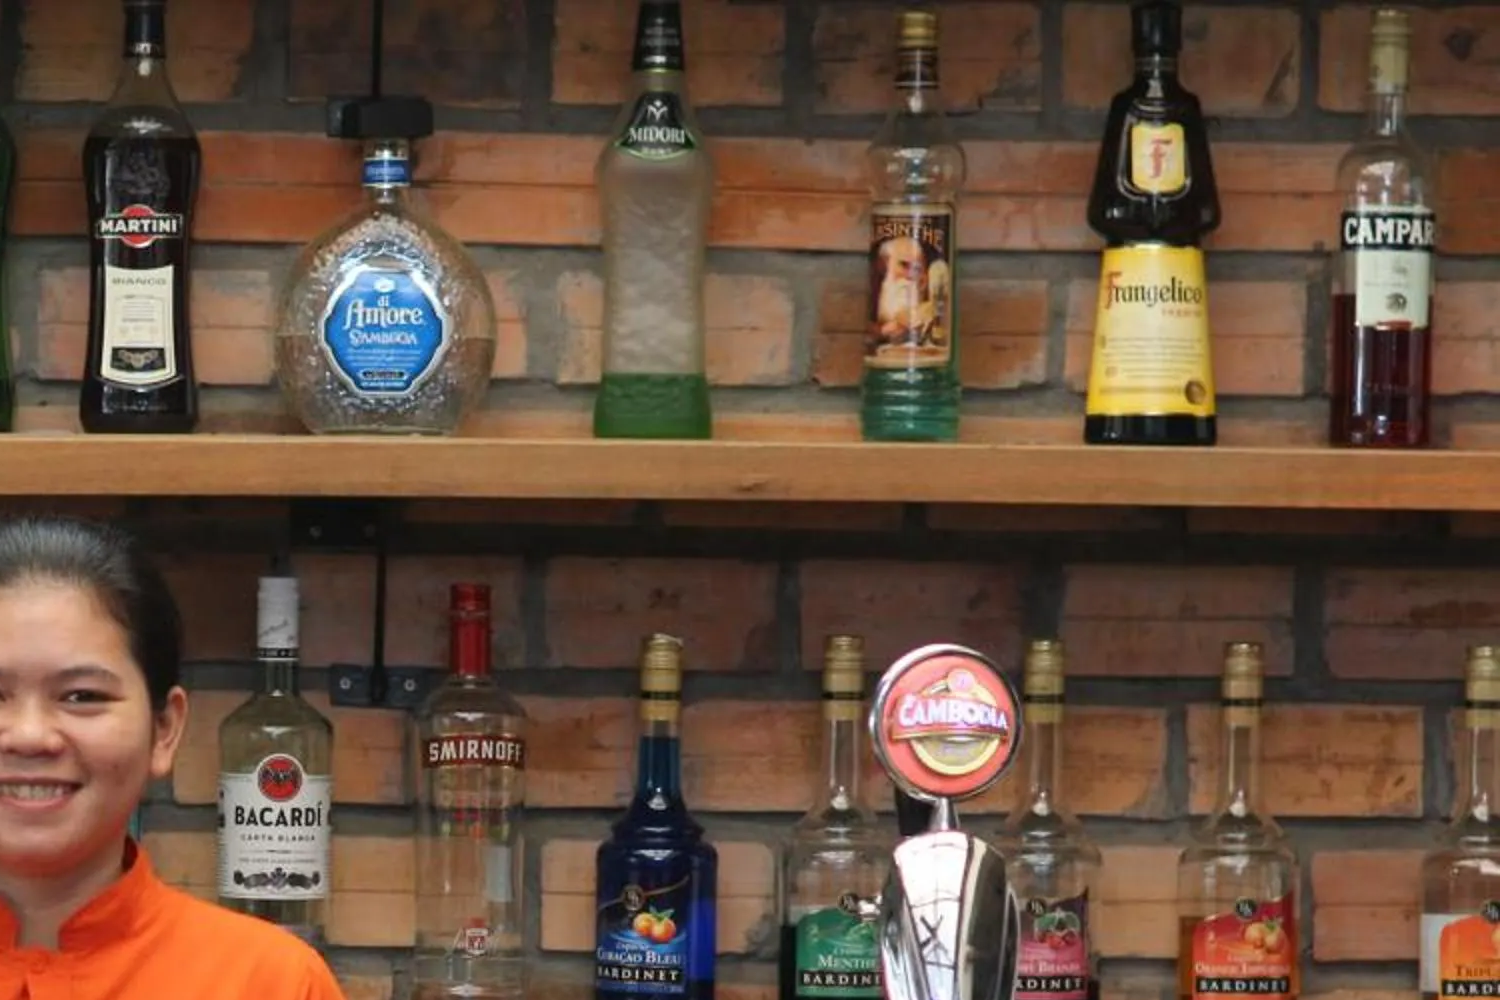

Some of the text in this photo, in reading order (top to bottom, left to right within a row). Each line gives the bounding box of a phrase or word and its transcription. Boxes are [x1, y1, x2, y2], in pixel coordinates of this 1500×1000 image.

[628, 126, 685, 144] MIDORI
[100, 219, 177, 234] MARTINI
[1344, 217, 1435, 245] CAMPAR
[1104, 271, 1203, 310] Frangelico
[343, 299, 424, 329] Amore
[899, 692, 1009, 730] CAMBODIA
[429, 740, 521, 763] SMIRNOFF
[818, 954, 878, 968] MENTH
[1446, 983, 1500, 994] BARDI
